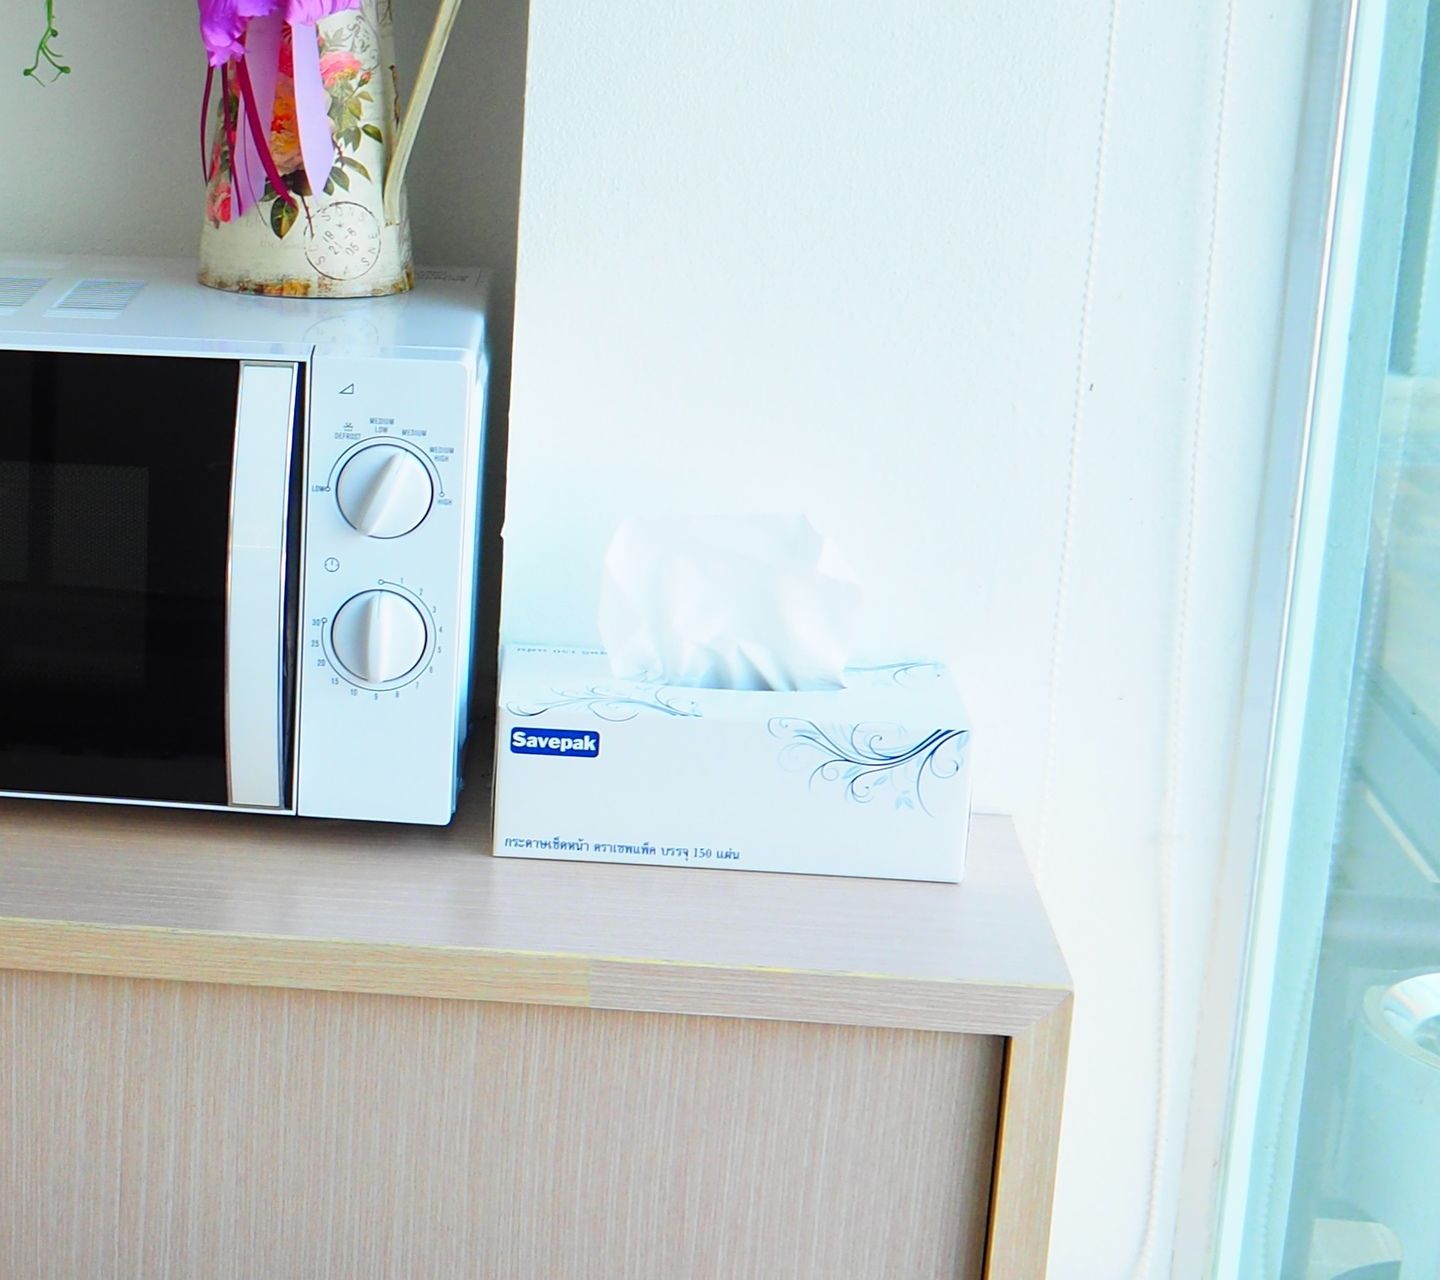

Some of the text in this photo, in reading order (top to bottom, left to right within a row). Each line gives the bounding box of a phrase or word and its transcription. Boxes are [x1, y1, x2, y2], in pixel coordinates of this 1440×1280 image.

[511, 731, 597, 752] Savepak
[661, 845, 689, 861] บรรจุ
[693, 847, 712, 859] 150
[716, 847, 741, 860] แผ่น
